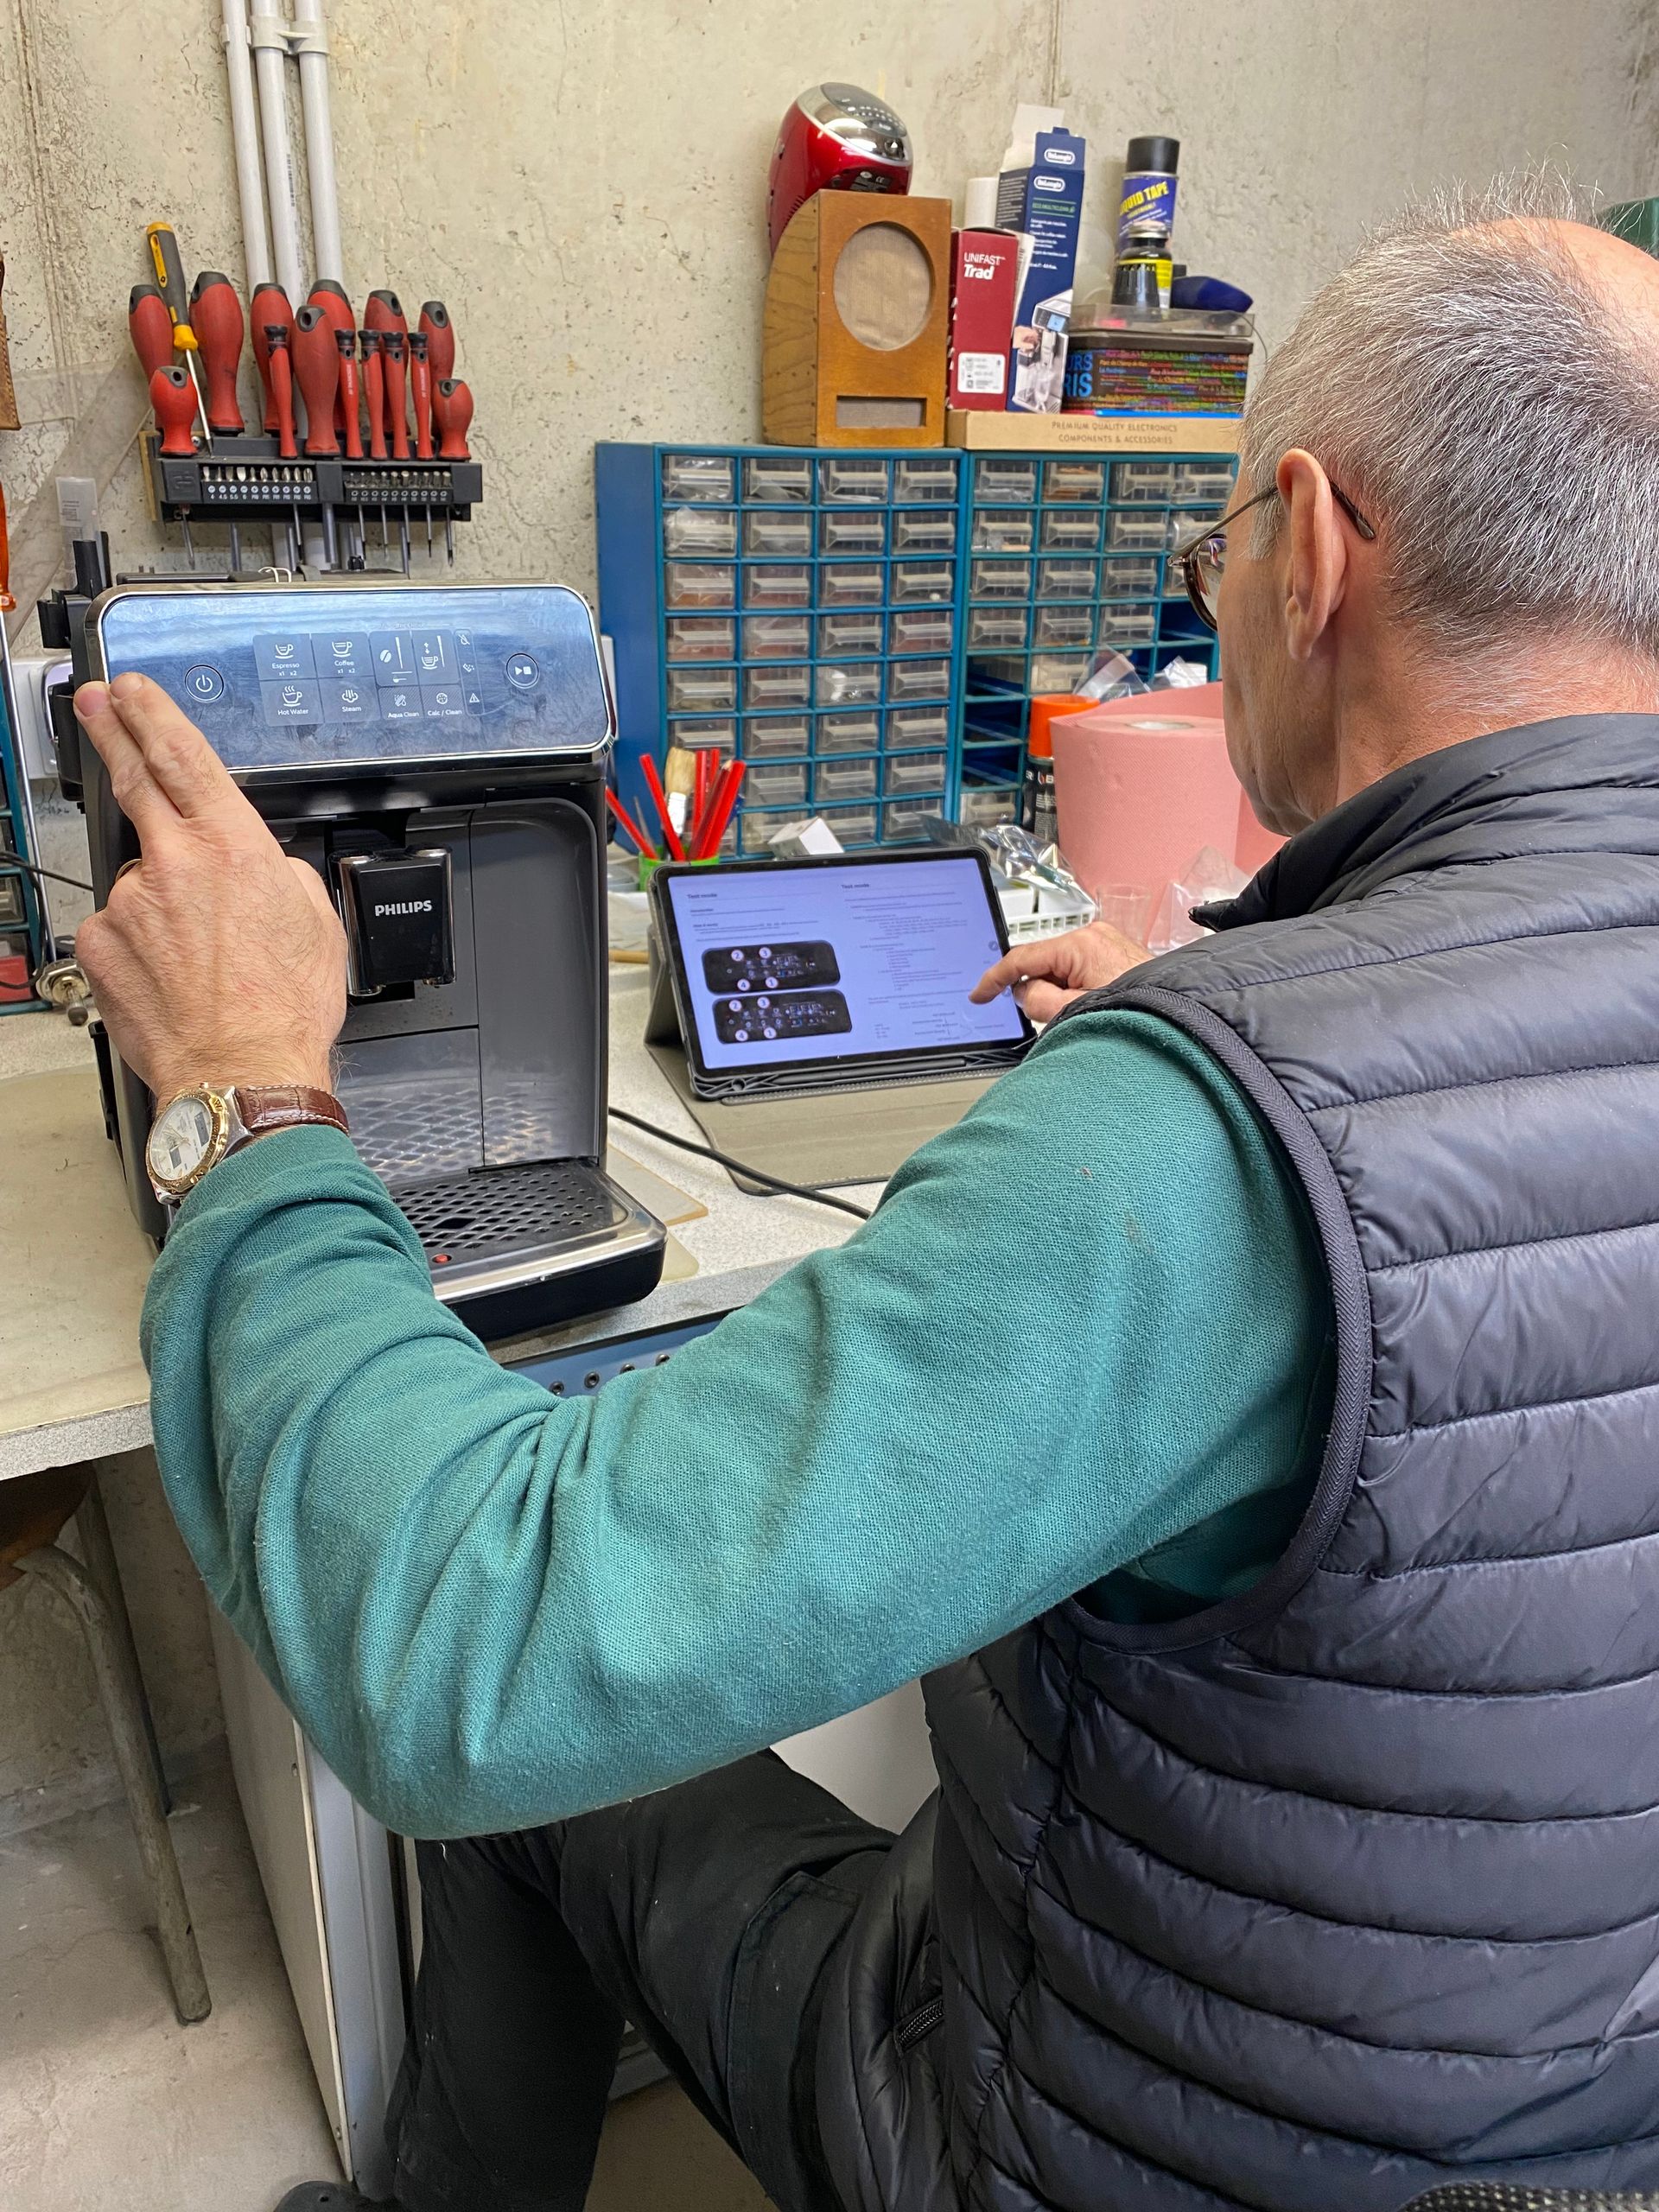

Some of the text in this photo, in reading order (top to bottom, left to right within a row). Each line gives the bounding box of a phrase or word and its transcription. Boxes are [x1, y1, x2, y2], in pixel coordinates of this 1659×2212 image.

[1143, 181, 1169, 200] TAPE
[963, 264, 995, 280] Trad
[1051, 421, 1178, 432] PREMIUM QUALITY ELECTRONICS
[1058, 434, 1113, 443] COMPONENTS
[1124, 435, 1173, 444] ACCESSORIES
[374, 899, 432, 917] PHILIPS
